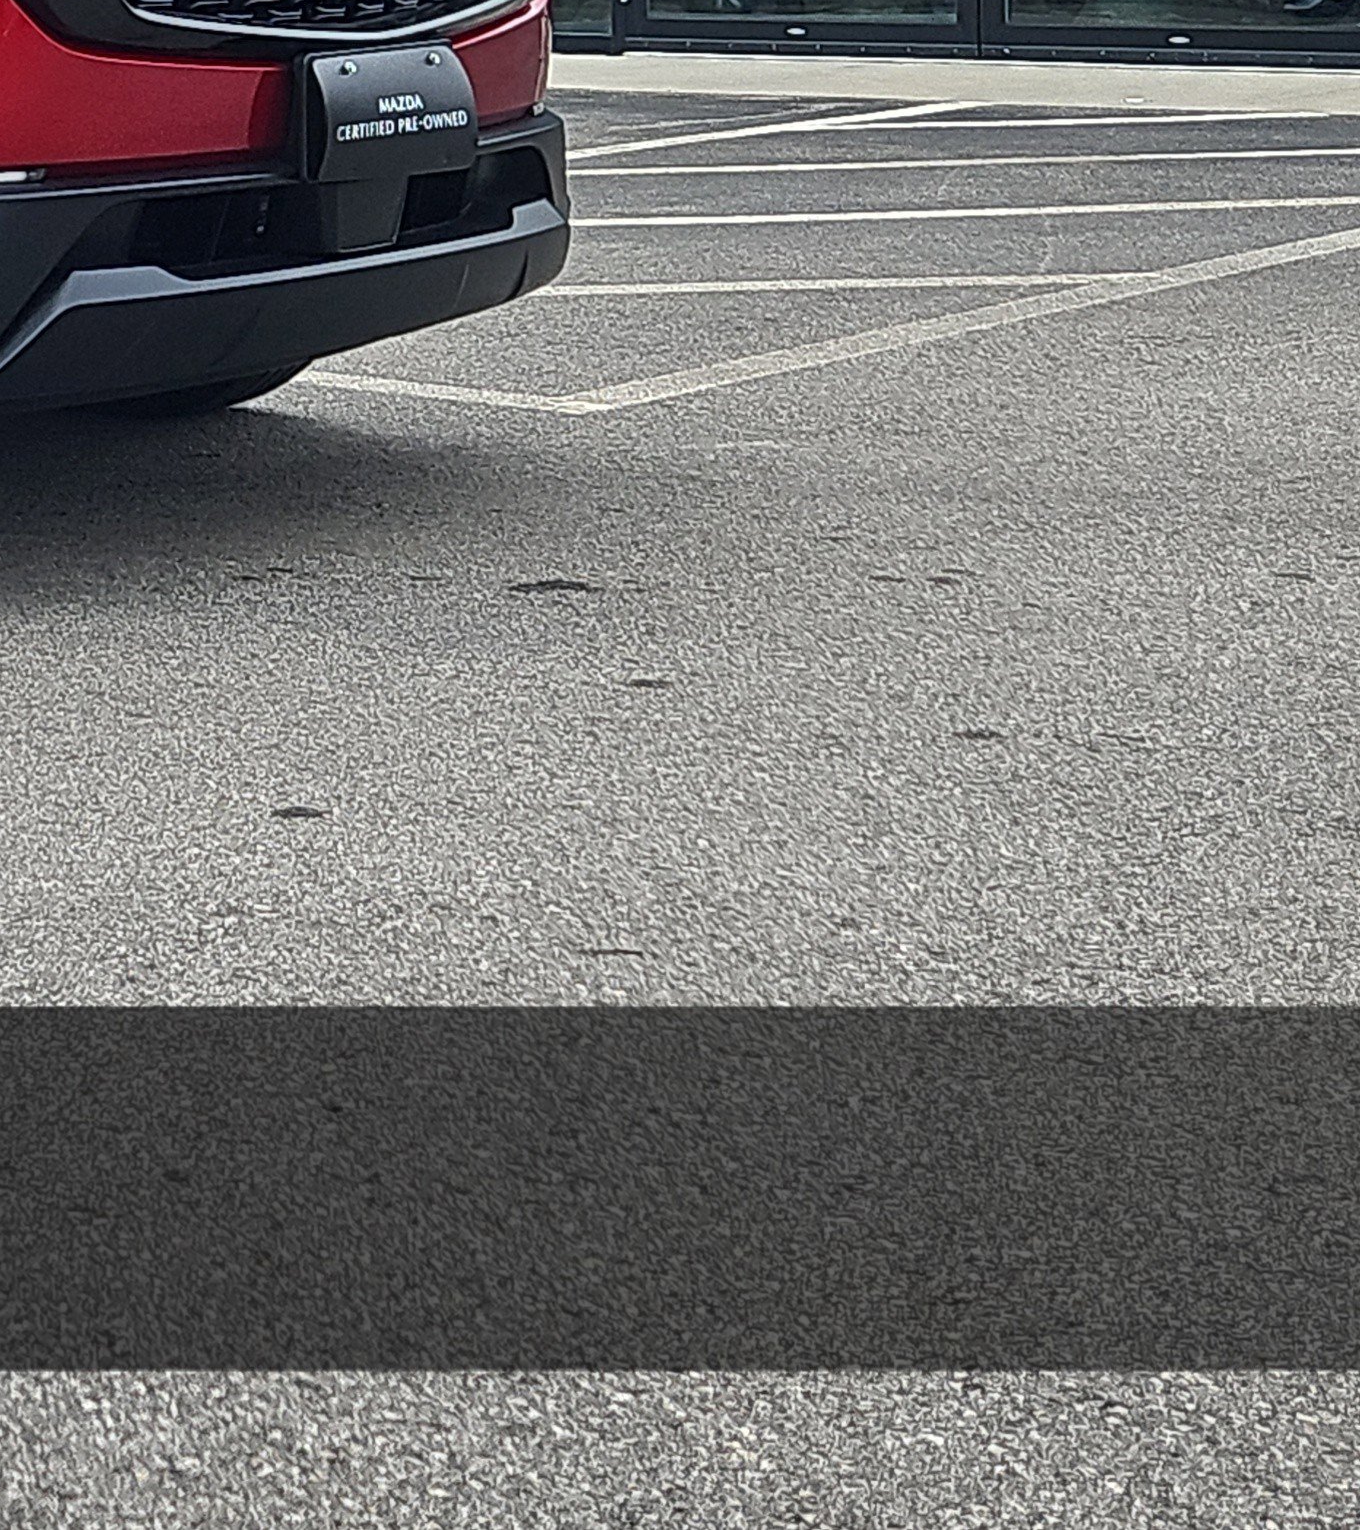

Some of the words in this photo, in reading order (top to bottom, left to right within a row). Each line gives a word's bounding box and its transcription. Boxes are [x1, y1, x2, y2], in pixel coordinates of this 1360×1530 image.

[378, 94, 424, 113] MAZDA
[336, 120, 395, 142] CERTIFIED
[398, 110, 468, 134] PRE-OWNED
